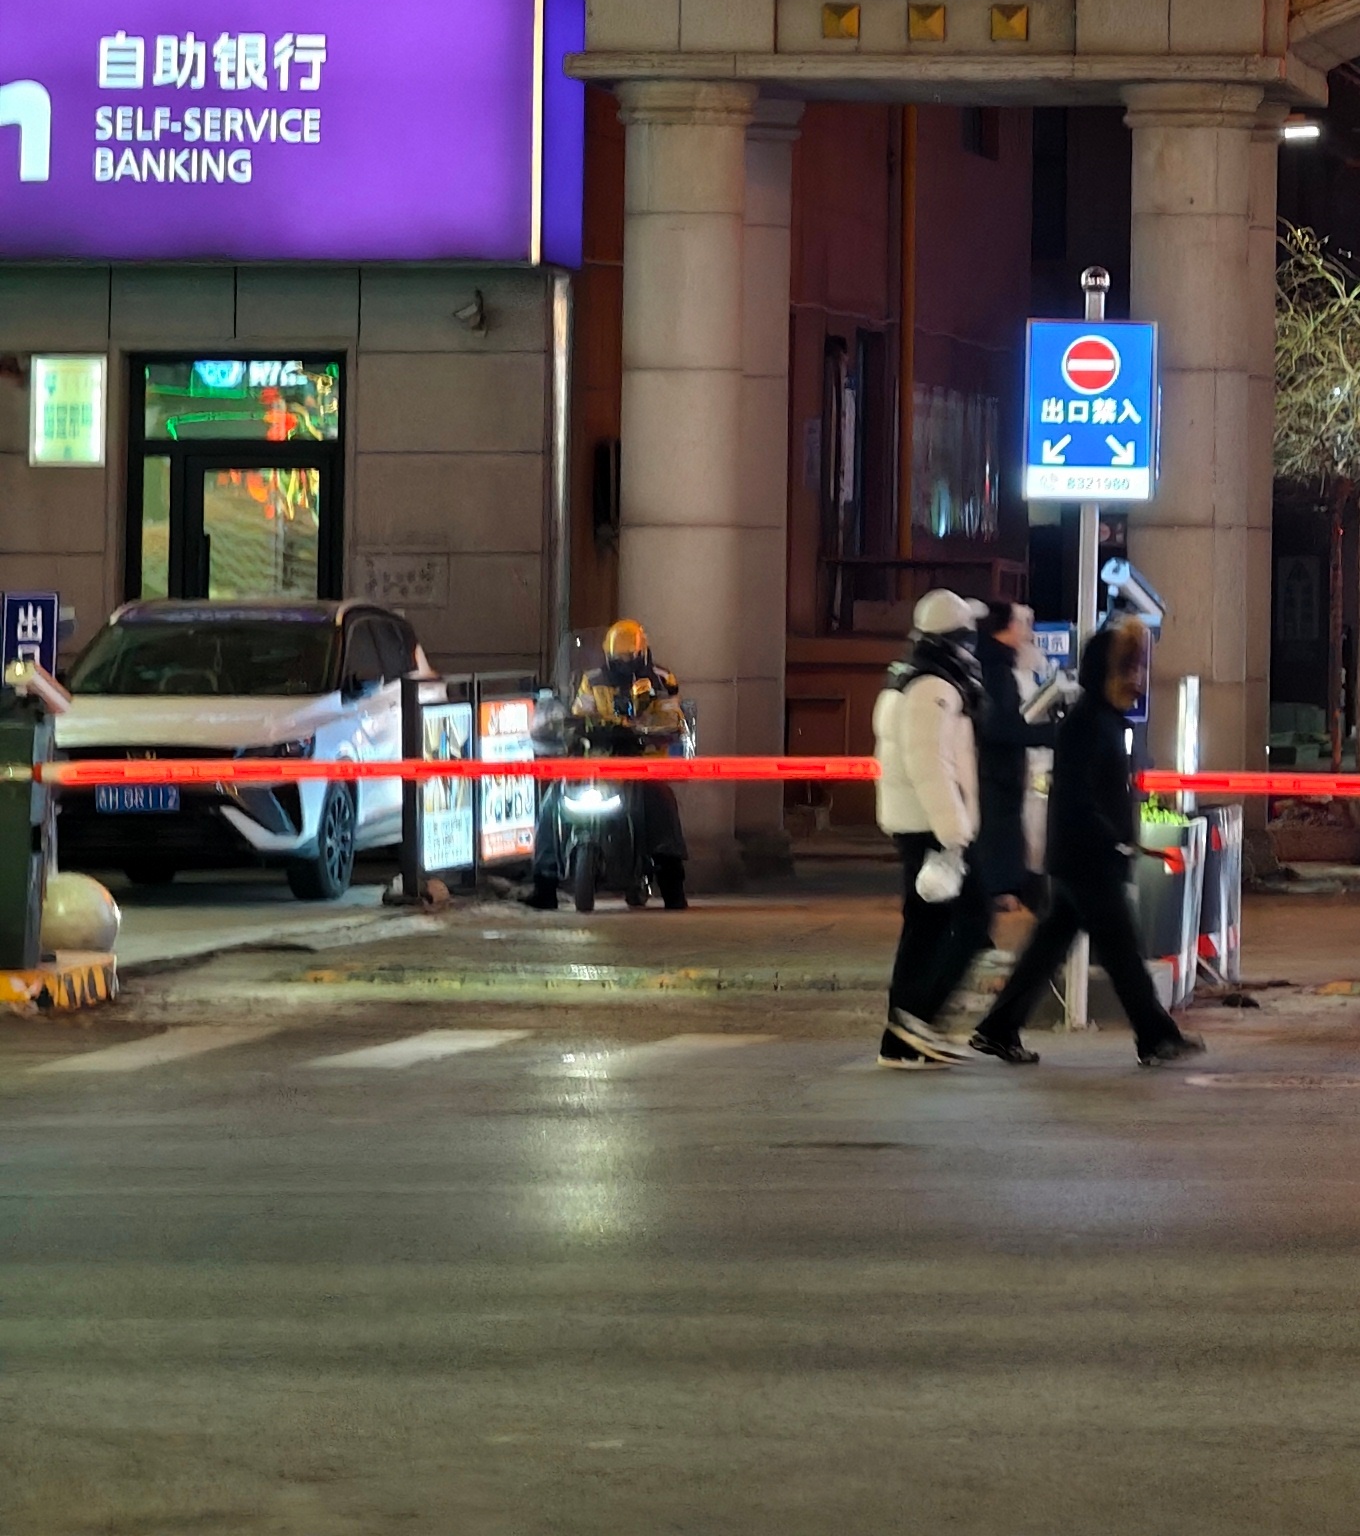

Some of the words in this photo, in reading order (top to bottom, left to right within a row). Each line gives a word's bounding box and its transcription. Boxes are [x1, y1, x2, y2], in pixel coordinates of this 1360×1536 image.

[98, 30, 327, 91] 自助银行
[94, 105, 321, 144] SELF-SERVICE
[94, 147, 252, 184] BANKING
[1041, 396, 1142, 425] 出口禁入
